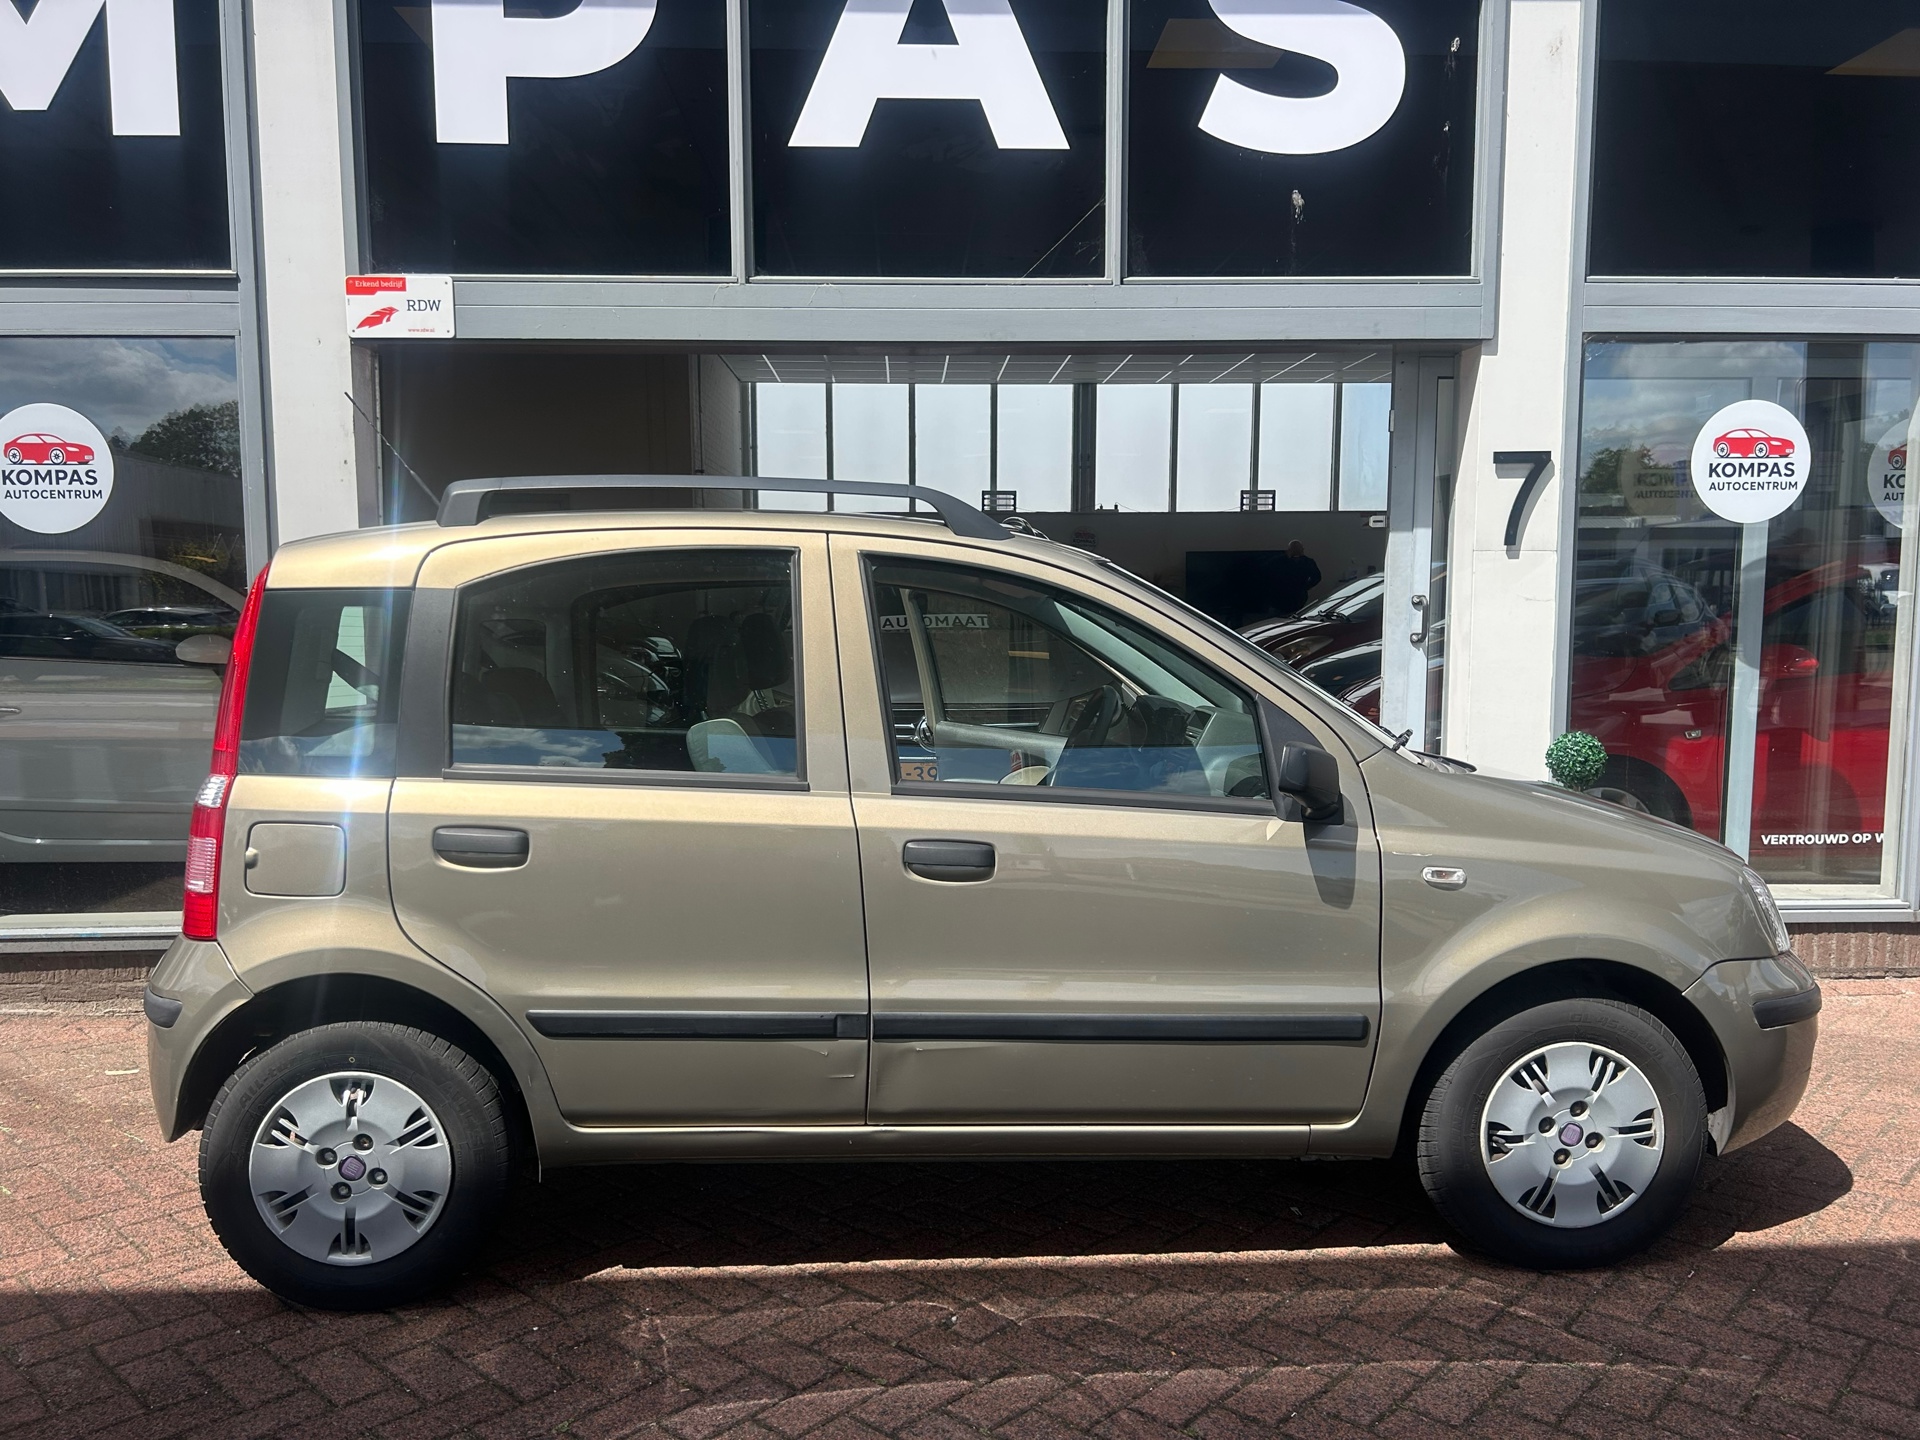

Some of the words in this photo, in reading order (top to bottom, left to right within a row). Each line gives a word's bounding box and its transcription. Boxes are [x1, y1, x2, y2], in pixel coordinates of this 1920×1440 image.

[355, 280, 380, 288] Erkend
[381, 280, 403, 289] bedrijf
[406, 299, 442, 312] RDW
[1708, 462, 1795, 478] KOMPAS
[1, 469, 98, 486] KOMPAS
[1708, 481, 1798, 491] AUTOCENTRUM
[4, 489, 103, 500] AUTOCENTRUM
[1493, 451, 1552, 546] 7
[882, 615, 988, 629] AUOMAAT
[1761, 833, 1849, 845] VERTROUWD
[1852, 833, 1872, 844] OP
